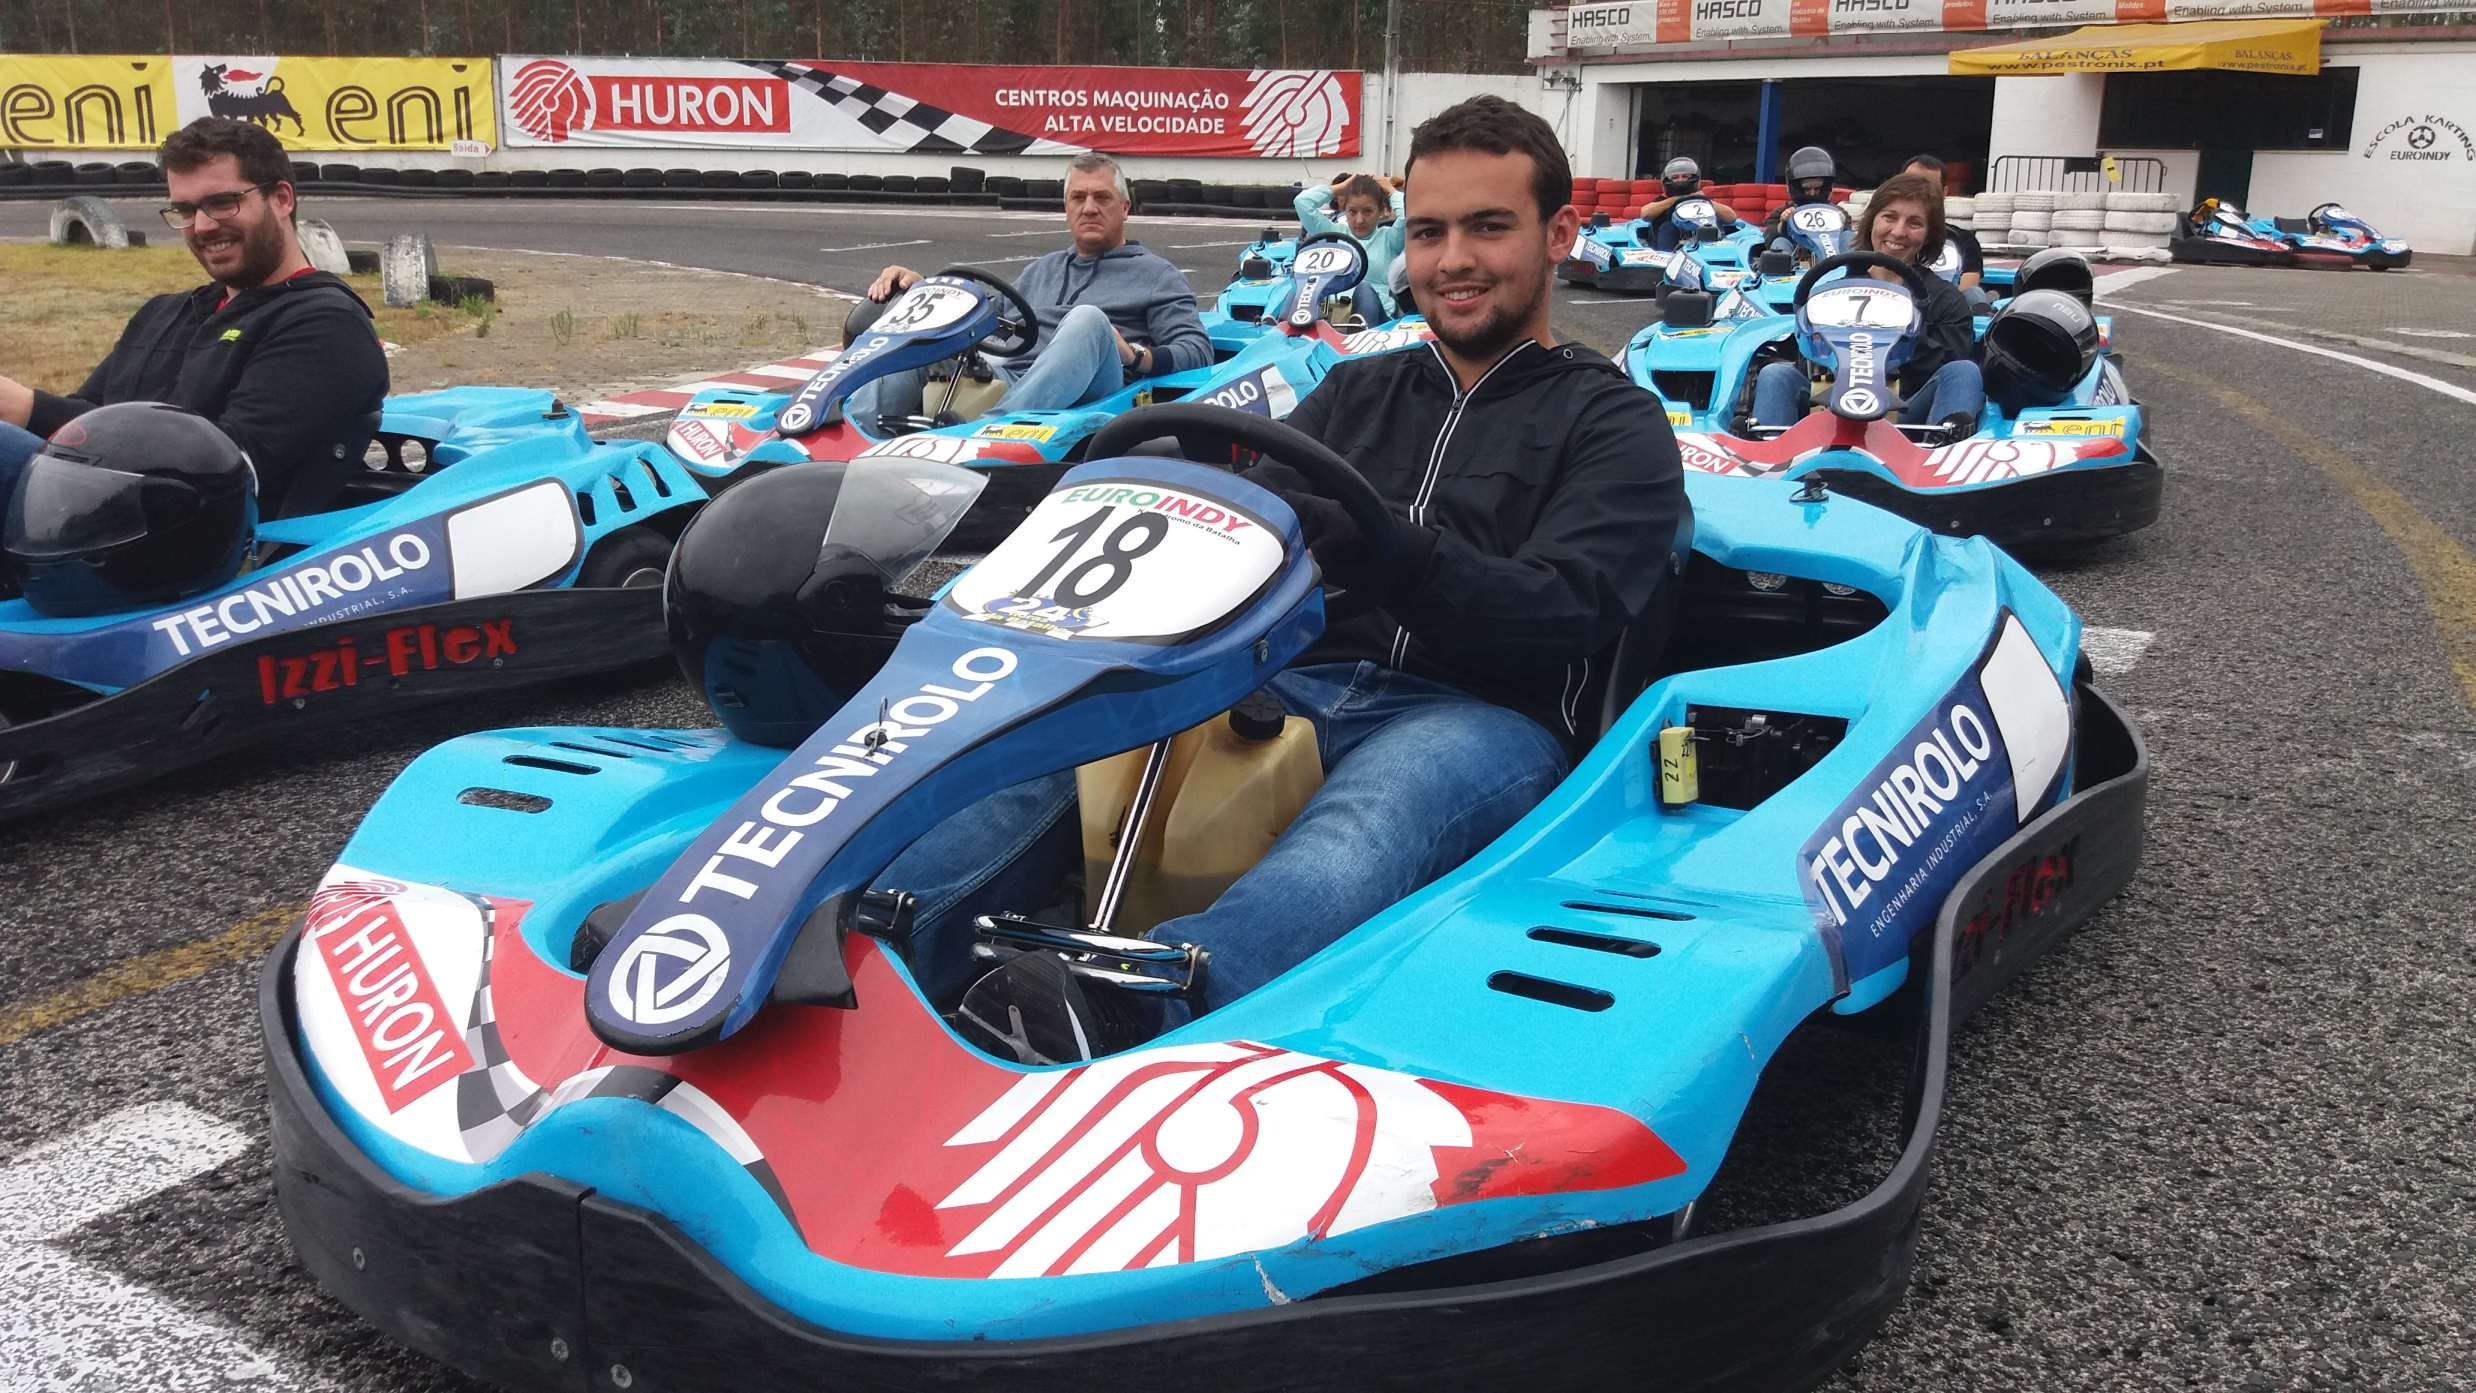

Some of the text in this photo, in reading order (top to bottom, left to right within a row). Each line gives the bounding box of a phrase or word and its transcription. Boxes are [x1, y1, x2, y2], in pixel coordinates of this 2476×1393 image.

[1572, 8, 1630, 28] HASCO
[1696, 0, 1763, 20] HASCO
[1993, 14, 2038, 25] Enabling
[2040, 12, 2062, 23] with
[2173, 5, 2225, 17] Enabling
[2229, 4, 2253, 15] with
[1696, 27, 1730, 39] Enabling
[1731, 26, 1749, 36] with
[1834, 20, 1874, 31] Enabling
[1877, 19, 1895, 29] with
[0, 61, 157, 145] eni
[325, 63, 474, 145] eni
[611, 83, 774, 127] HURON
[995, 88, 1230, 113] CENTROS MAQUINAÇÃO
[1044, 115, 1226, 135] ALTA VELOCIDADE
[2363, 114, 2476, 162] ESCOLA KARTING
[2390, 150, 2452, 161] EUROINDY
[1803, 211, 1826, 228] 26
[1306, 251, 1335, 270] 20
[889, 293, 946, 325] 35
[1848, 295, 1872, 323] 7
[2052, 302, 2081, 323] nau
[679, 421, 720, 458] HURON
[1060, 487, 1254, 533] EUROINDY
[1205, 526, 1241, 546] Batalha
[1014, 505, 1169, 609] 18
[152, 532, 432, 657] TECNIROLO
[678, 646, 1018, 904] TECNIROLO
[1810, 704, 1991, 927] TECNIROLO
[1869, 790, 1993, 939] ENGENHARIA INDUSTRIAL, S.A.
[333, 915, 456, 1092] HURON
